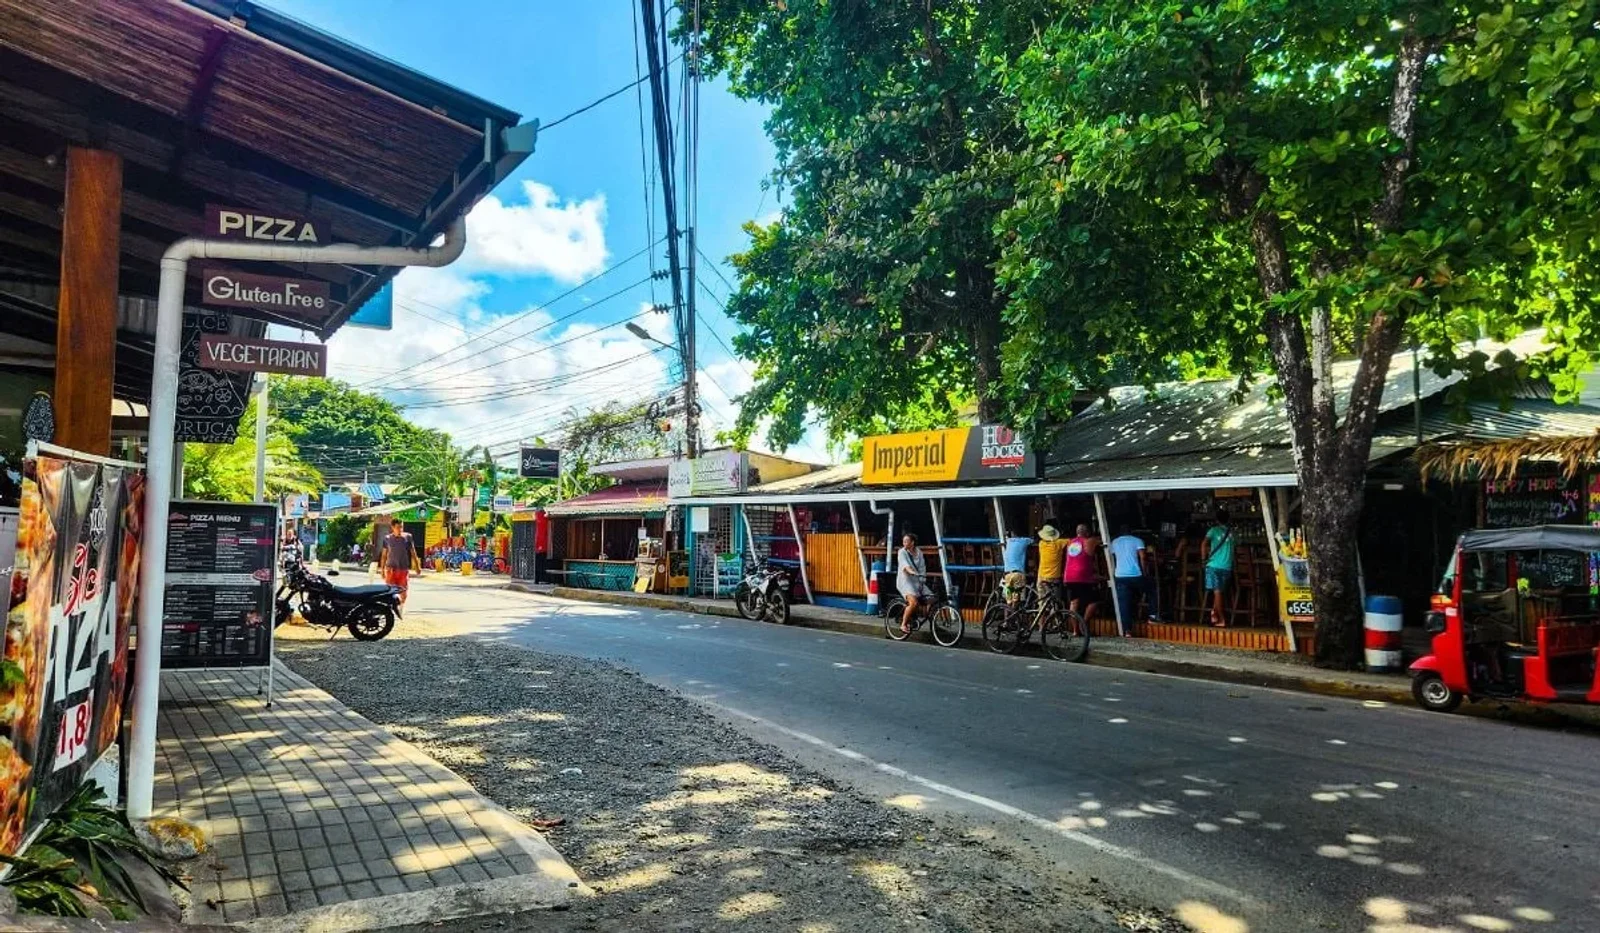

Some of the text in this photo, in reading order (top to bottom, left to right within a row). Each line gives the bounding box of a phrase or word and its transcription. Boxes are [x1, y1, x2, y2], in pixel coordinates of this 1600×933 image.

[219, 210, 318, 242] PIZZA
[208, 276, 326, 308] Gluten Free
[206, 341, 320, 369] VEGETARIAN
[872, 433, 947, 477] Imperial
[981, 444, 1025, 460] ROCKS
[1485, 476, 1567, 495] HAPPY HOURS
[190, 514, 242, 523] PIZZA MENU
